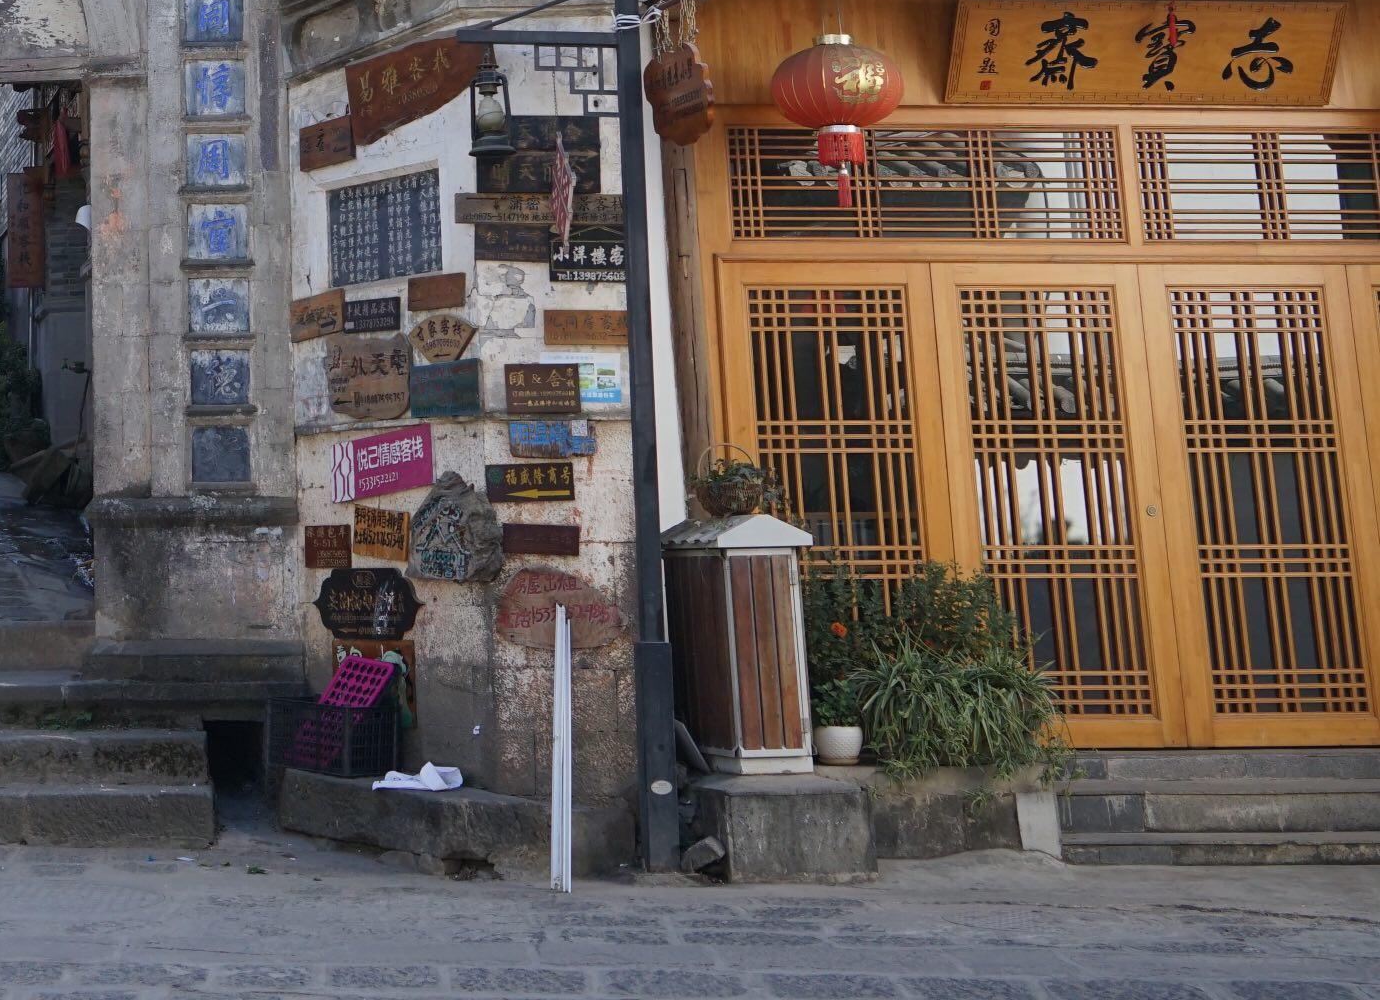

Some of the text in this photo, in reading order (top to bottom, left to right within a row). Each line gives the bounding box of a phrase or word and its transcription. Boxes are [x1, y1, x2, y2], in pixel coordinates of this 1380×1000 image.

[356, 435, 424, 473] 悦己情感客栈
